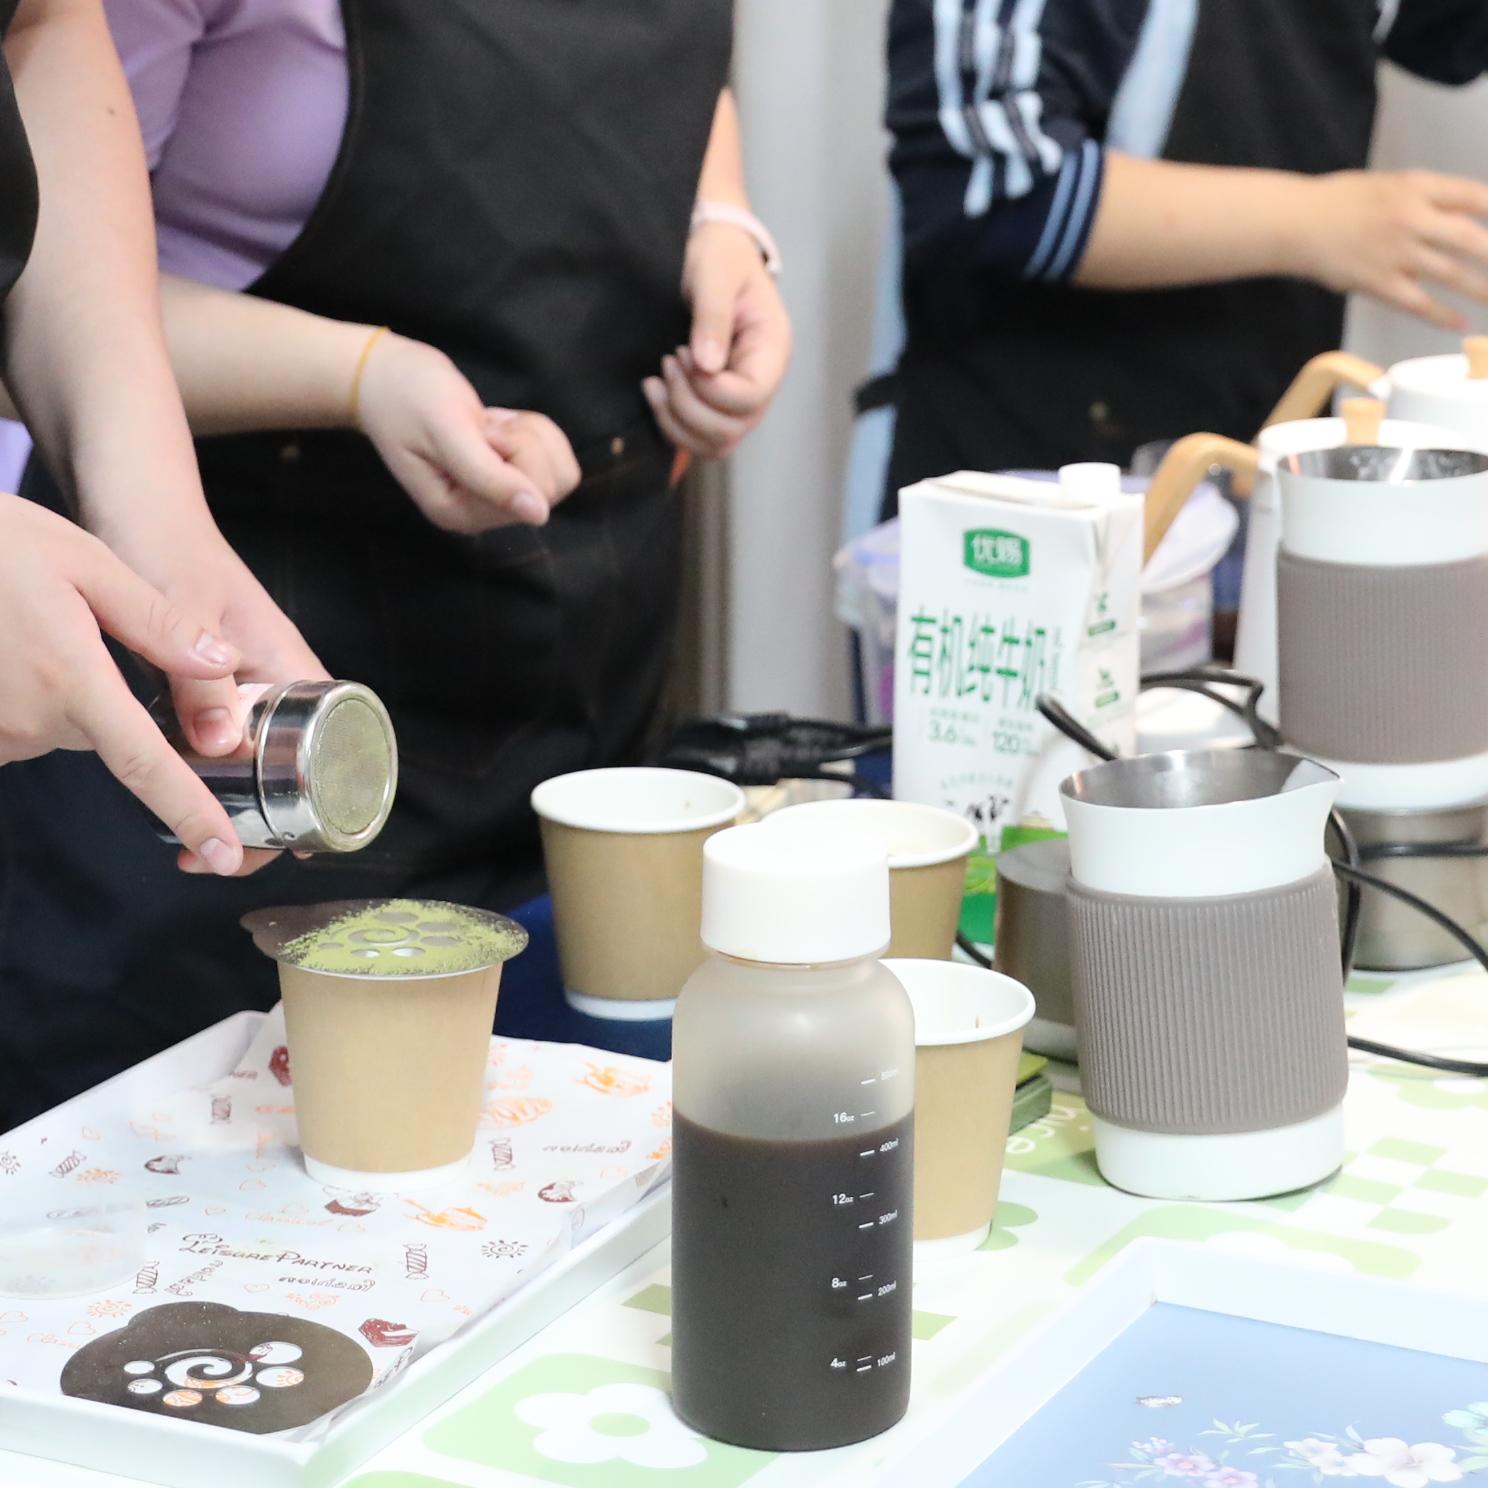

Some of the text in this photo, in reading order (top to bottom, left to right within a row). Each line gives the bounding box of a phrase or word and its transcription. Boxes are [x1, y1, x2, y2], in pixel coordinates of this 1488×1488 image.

[908, 604, 1046, 711] 有机纯牛奶
[879, 1137, 899, 1153] 400ml
[879, 1209, 898, 1225] 300ml
[878, 1280, 897, 1297] 200ml
[877, 1352, 896, 1367] 100ml
